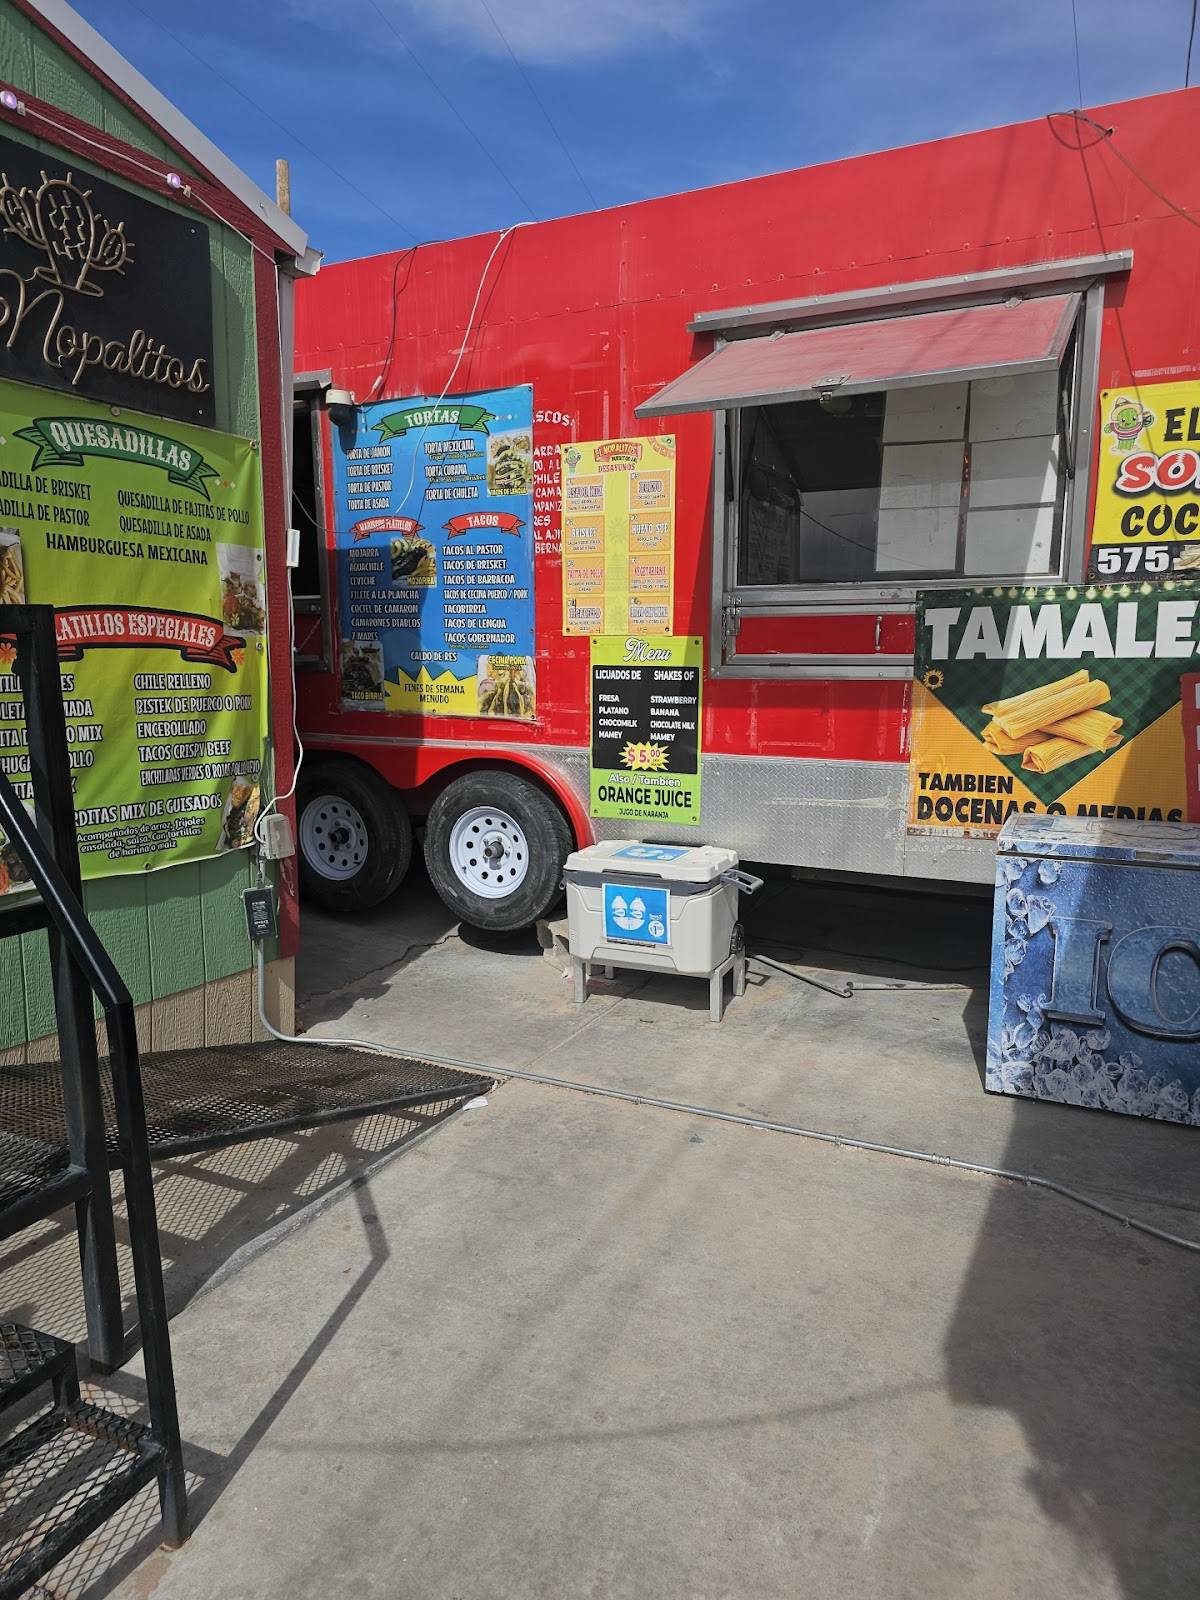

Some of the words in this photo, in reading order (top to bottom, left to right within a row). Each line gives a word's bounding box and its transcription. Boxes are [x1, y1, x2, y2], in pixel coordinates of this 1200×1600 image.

[404, 409, 460, 427] TORTAS
[50, 421, 192, 472] QUESADILLAS
[424, 441, 443, 454] TORTA
[443, 438, 475, 453] MEXICANA
[347, 465, 363, 476] TORTA
[363, 464, 371, 475] DE
[371, 463, 393, 475] BRISKET
[424, 464, 443, 477] TORTA
[443, 463, 468, 476] CUBANA
[598, 464, 636, 473] DESAYUNOS
[1115, 449, 1200, 493] SO
[0, 470, 33, 491] DILLA
[36, 475, 49, 493] DE
[51, 478, 91, 501] BRISKET
[364, 481, 371, 492] DE
[371, 480, 392, 491] PASTOR
[425, 488, 444, 500] TORTA
[444, 488, 452, 499] DE
[452, 487, 479, 499] CHULETA
[118, 489, 171, 514] QUESADILLA
[172, 499, 183, 515] DE
[184, 501, 215, 520] FAJITAS
[216, 506, 226, 521] DE
[227, 508, 250, 525] POLLO
[348, 499, 364, 510] TORTA
[364, 498, 371, 509] DE
[372, 497, 389, 508] ASADA
[38, 503, 50, 521] DE
[53, 505, 90, 527] PASTOR
[466, 514, 499, 527] TACOS
[119, 515, 172, 538] QUESADILLA
[174, 523, 185, 539] DE
[186, 525, 212, 542] ASADA
[46, 532, 144, 560] HAMBURGUESA
[148, 544, 208, 565] MEXICANA
[349, 549, 380, 558] MOJARRA
[442, 545, 464, 556] TACOS
[465, 545, 475, 555] AL
[476, 544, 504, 555] PASTOR
[443, 560, 464, 570] TACOS
[466, 560, 476, 570] DE
[477, 559, 507, 569] BRISKET
[1097, 545, 1170, 574] 575
[349, 562, 384, 572] AGUACHILE
[350, 576, 375, 586] CEVICHE
[443, 575, 465, 585] TACOS
[466, 575, 476, 584] DE
[477, 574, 515, 584] BARBACOA
[350, 590, 370, 600] FILETE
[371, 590, 377, 599] A
[377, 590, 387, 599] LA
[387, 590, 420, 599] PLANCHA
[443, 589, 460, 599] TACOS
[460, 590, 467, 599] DE
[467, 590, 487, 599] CECINA
[487, 590, 508, 599] PUERCO
[513, 589, 528, 599] PORK
[351, 604, 373, 613] COCTEL
[374, 604, 382, 613] DE
[384, 604, 418, 613] CAMARON
[443, 604, 487, 614] TACOBIRRIA
[351, 618, 391, 627] CAMARONES
[391, 618, 421, 628] DIABLOS
[444, 618, 466, 629] TACOS
[467, 618, 477, 629] DE
[478, 619, 507, 629] LENGUA
[127, 612, 216, 648] ESPECIALES
[357, 631, 378, 641] MARES
[924, 600, 1200, 660] TAMALE
[444, 632, 466, 643] TACOS
[467, 633, 516, 644] GOBERNADOR
[411, 651, 432, 661] CALDO
[434, 651, 443, 661] DE
[444, 651, 457, 661] RES
[623, 637, 672, 662] Menu
[135, 674, 165, 690] CHILE
[167, 673, 211, 690] RELLENO
[595, 670, 630, 680] LICUADOS
[631, 670, 642, 680] DE
[653, 670, 682, 681] SHAKES
[683, 670, 695, 681] OF
[404, 683, 424, 693] FINES
[425, 684, 433, 693] DE
[435, 684, 465, 694] SEMANA
[136, 697, 173, 715] BISTEK
[174, 696, 188, 713] DE
[190, 696, 223, 712] PUERCO
[225, 695, 234, 711] O
[419, 694, 449, 703] MENUDO
[598, 694, 620, 703] FRESA
[650, 695, 697, 705] STRAWBERRY
[598, 706, 629, 715] PLATANO
[650, 708, 680, 717] BANANA
[137, 719, 206, 738] ENCEBOLLADO
[598, 719, 638, 728] CHOCOMILK
[650, 720, 682, 730] CHOCOLATE
[682, 721, 696, 730] MILK
[78, 725, 102, 741] MIX
[598, 730, 623, 739] MAMEY
[650, 733, 676, 742] MAMEY
[139, 745, 172, 762] TACOS
[173, 742, 205, 759] CRISPY
[206, 740, 231, 756] BEEF
[141, 766, 180, 786] ENCHILADAS
[181, 765, 204, 782] VERDES
[608, 773, 630, 784] Also
[639, 775, 681, 787] Tambien
[918, 773, 1014, 795] TAMBIEN
[598, 785, 651, 805] ORANGE
[654, 789, 692, 808] JUICE
[121, 803, 146, 821] MIX
[149, 801, 164, 817] DE
[166, 793, 222, 813] GUISADOS
[618, 808, 634, 817] JUGO
[634, 809, 643, 817] DE
[643, 810, 669, 819] NARANJA
[917, 795, 1037, 825] DOCENAS
[77, 828, 139, 843] Acompañados
[140, 824, 150, 833] de
[174, 817, 205, 829] frijoles
[81, 840, 125, 853] ensalada,
[152, 832, 166, 841] Con
[167, 826, 202, 839] tortillas
[109, 849, 120, 859] de
[121, 845, 150, 857] harina
